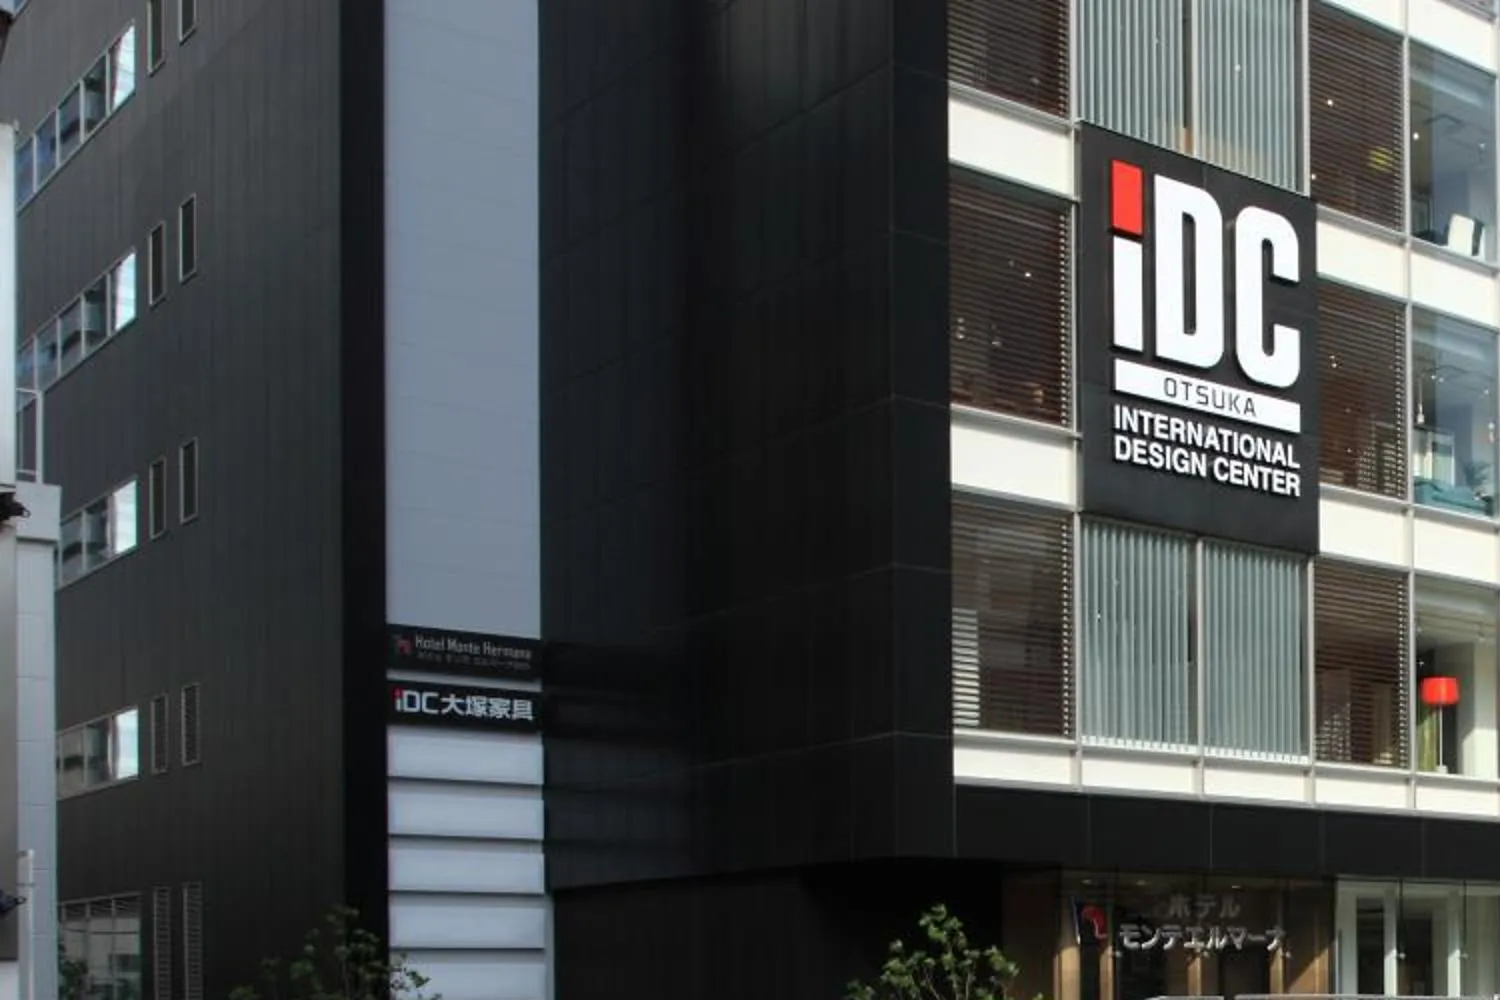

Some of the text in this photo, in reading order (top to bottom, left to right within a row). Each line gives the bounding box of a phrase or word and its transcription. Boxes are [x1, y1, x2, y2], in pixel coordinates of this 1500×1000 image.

[1111, 159, 1300, 388] iDC
[1163, 376, 1257, 418] OTSUKA
[1114, 404, 1300, 468] INTERNATIONAL
[1114, 436, 1300, 497] DESIGN CENTER
[415, 634, 445, 651] Hotel
[1169, 894, 1242, 919] ホテル
[1119, 923, 1286, 950] モンテエルマーナ
